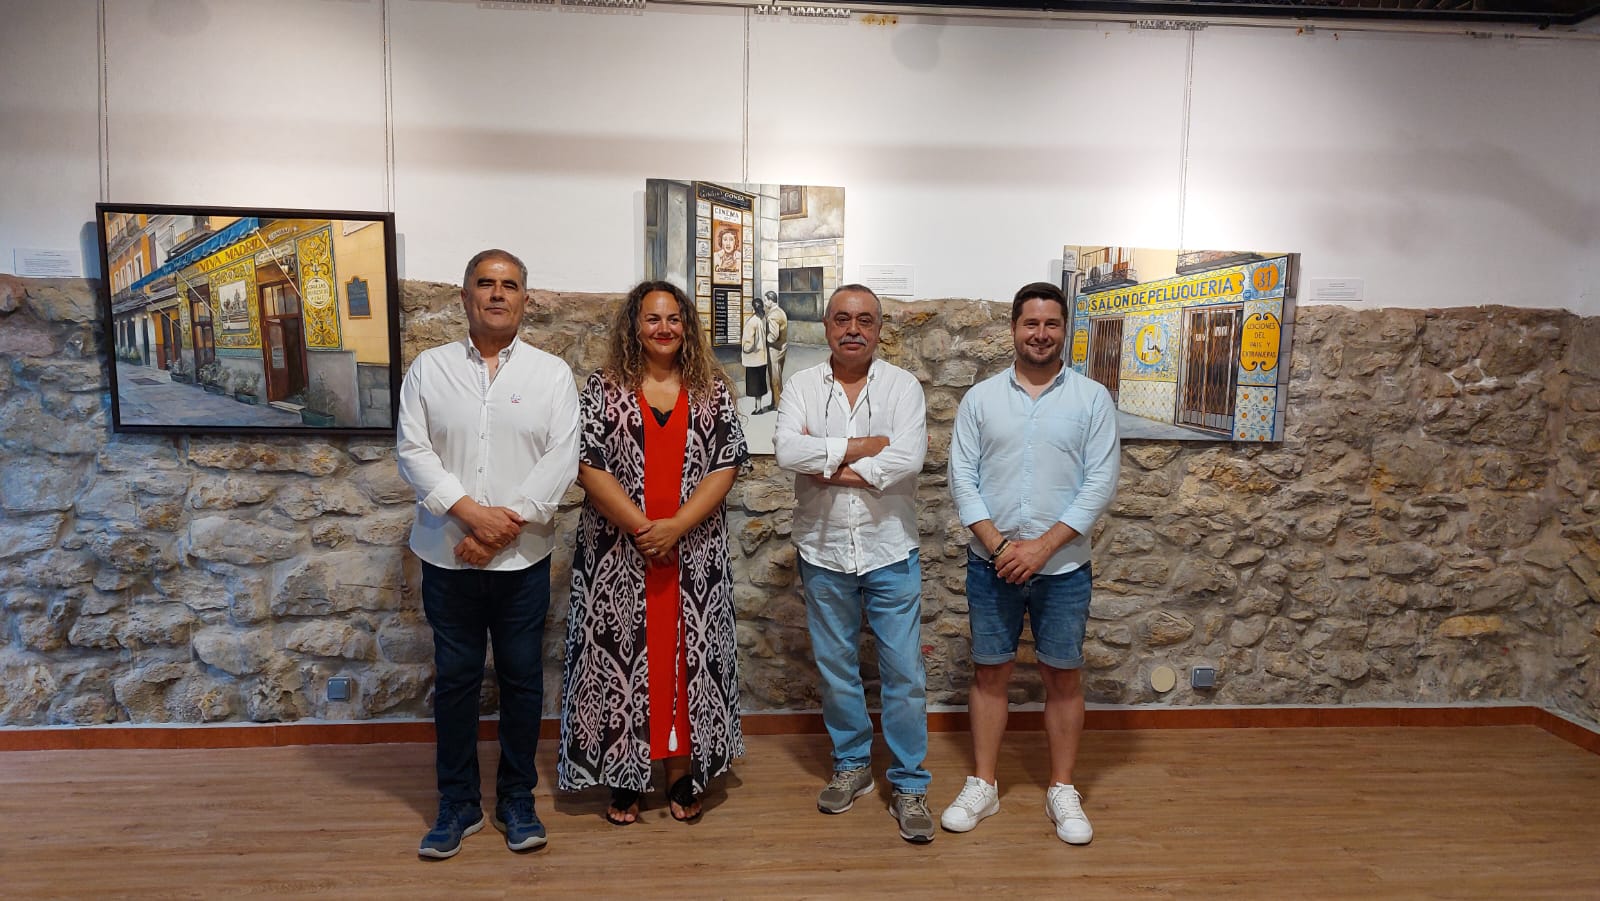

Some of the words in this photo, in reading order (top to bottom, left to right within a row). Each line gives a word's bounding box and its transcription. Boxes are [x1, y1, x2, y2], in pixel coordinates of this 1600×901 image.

[714, 207, 739, 218] CINEMA
[199, 256, 222, 272] VIVA
[224, 237, 263, 262] MADRID
[1257, 270, 1272, 288] 31
[1090, 294, 1129, 311] SALON
[1131, 290, 1145, 305] DE
[1147, 277, 1234, 304] PELUQUERIA
